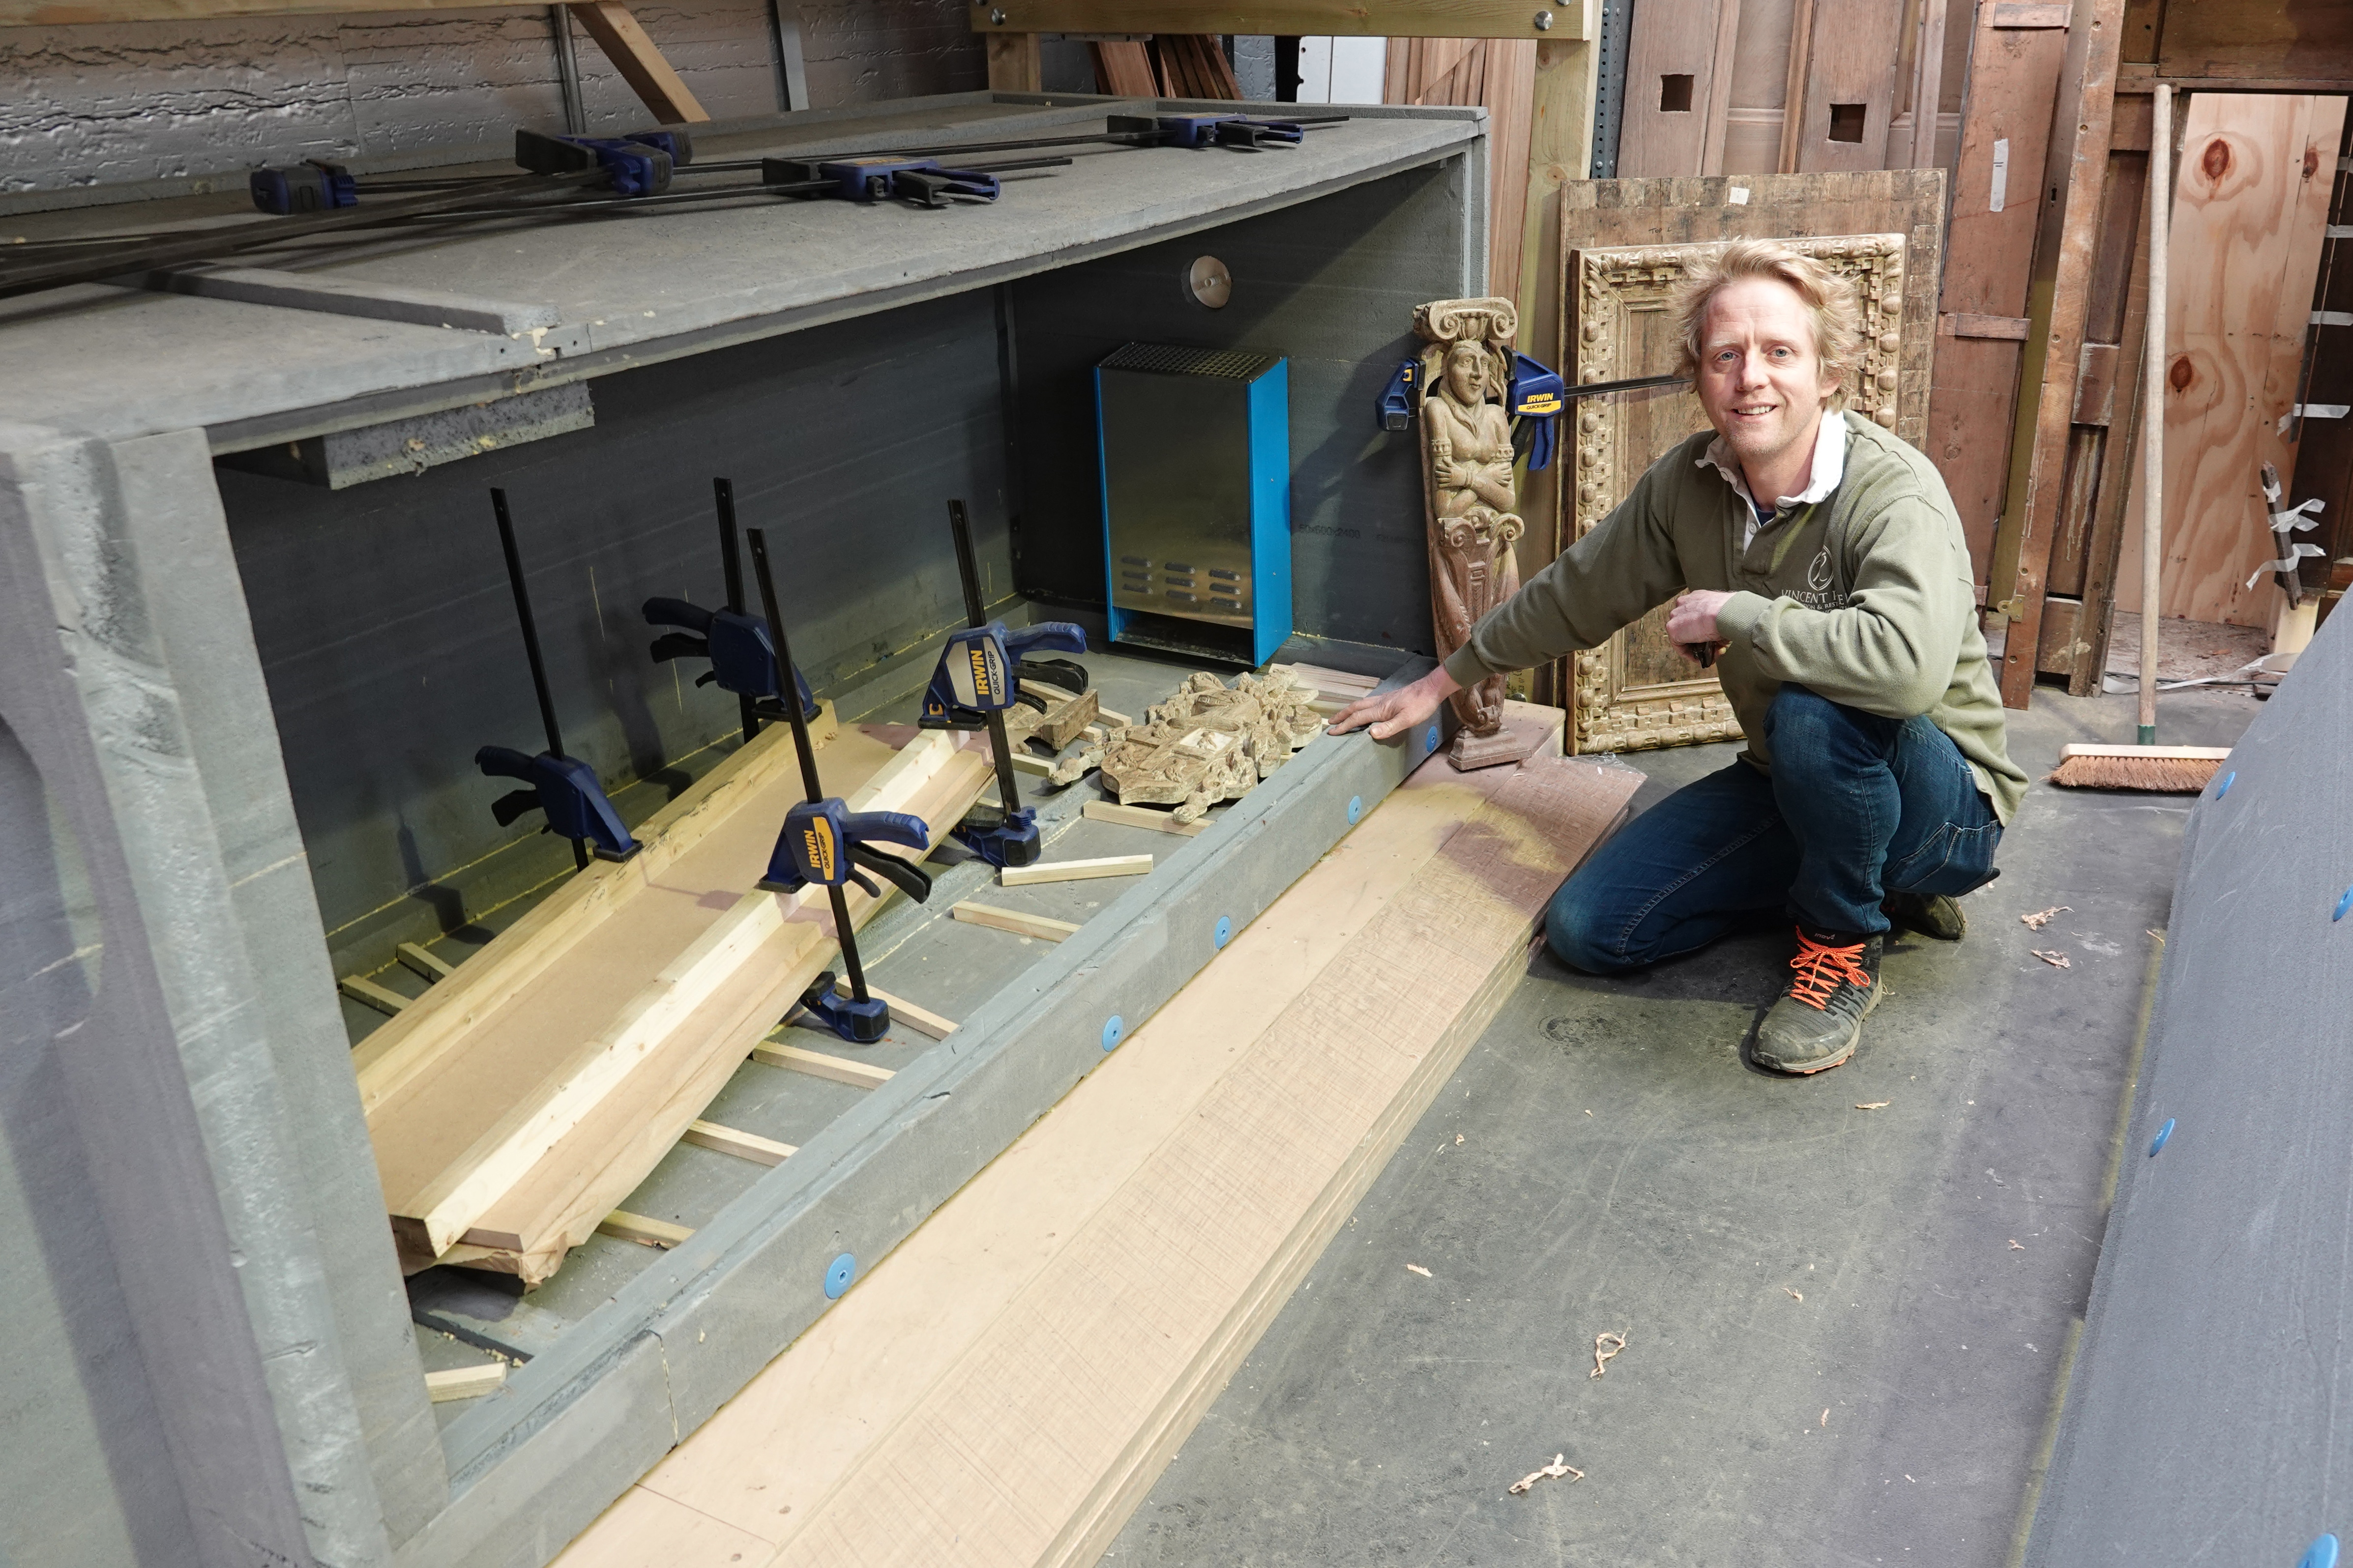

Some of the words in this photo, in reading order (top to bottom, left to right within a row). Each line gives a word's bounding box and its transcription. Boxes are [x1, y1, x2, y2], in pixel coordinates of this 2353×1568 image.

[1527, 393, 1554, 403] IRWIN
[1781, 589, 1828, 604] VINCENT
[971, 650, 990, 695] IRWIN
[978, 651, 1000, 695] QUICK-GRIP
[804, 830, 822, 869] IRWIN
[819, 832, 830, 869] QUICK-GRIP
